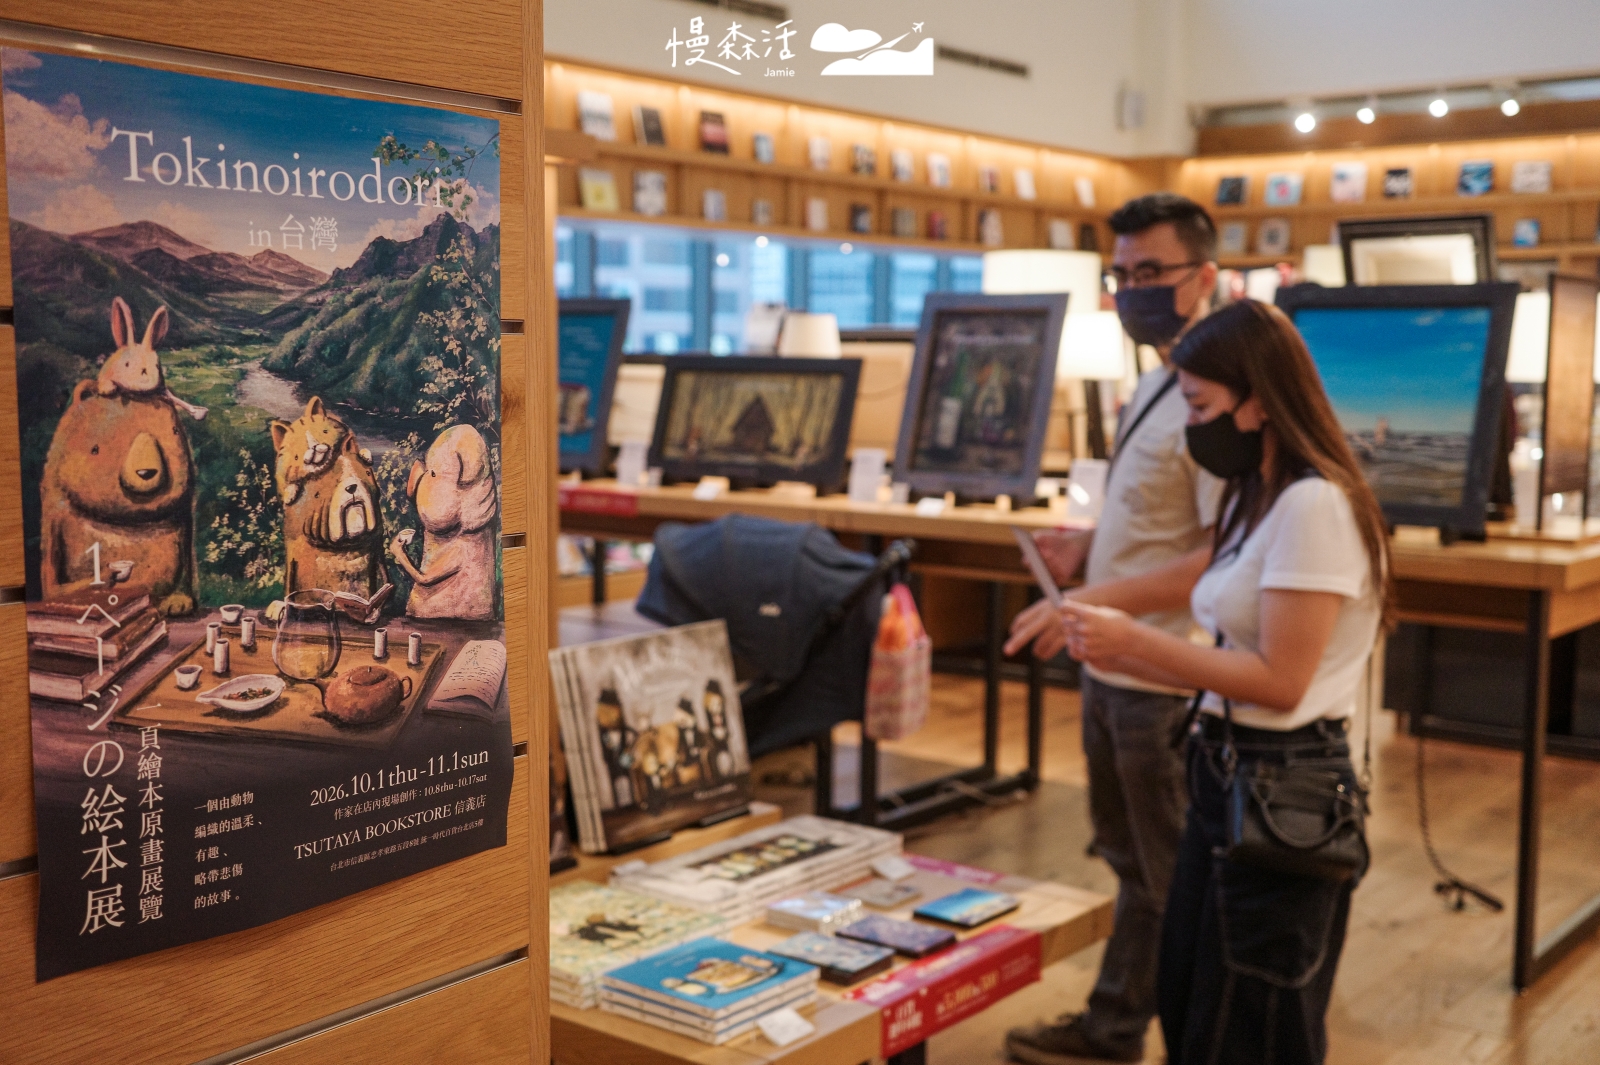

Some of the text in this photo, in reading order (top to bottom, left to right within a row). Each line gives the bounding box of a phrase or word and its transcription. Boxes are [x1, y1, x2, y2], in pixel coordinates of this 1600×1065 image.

[110, 126, 444, 208] Tokinoirodori
[248, 213, 340, 254] in 台灣
[136, 702, 165, 925] 一頁繪本原畫展覽
[193, 791, 254, 813] 一個由動物
[293, 794, 487, 860] TSUTAYA BOOKSTORE 信義店
[194, 863, 244, 886] 略帶悲傷
